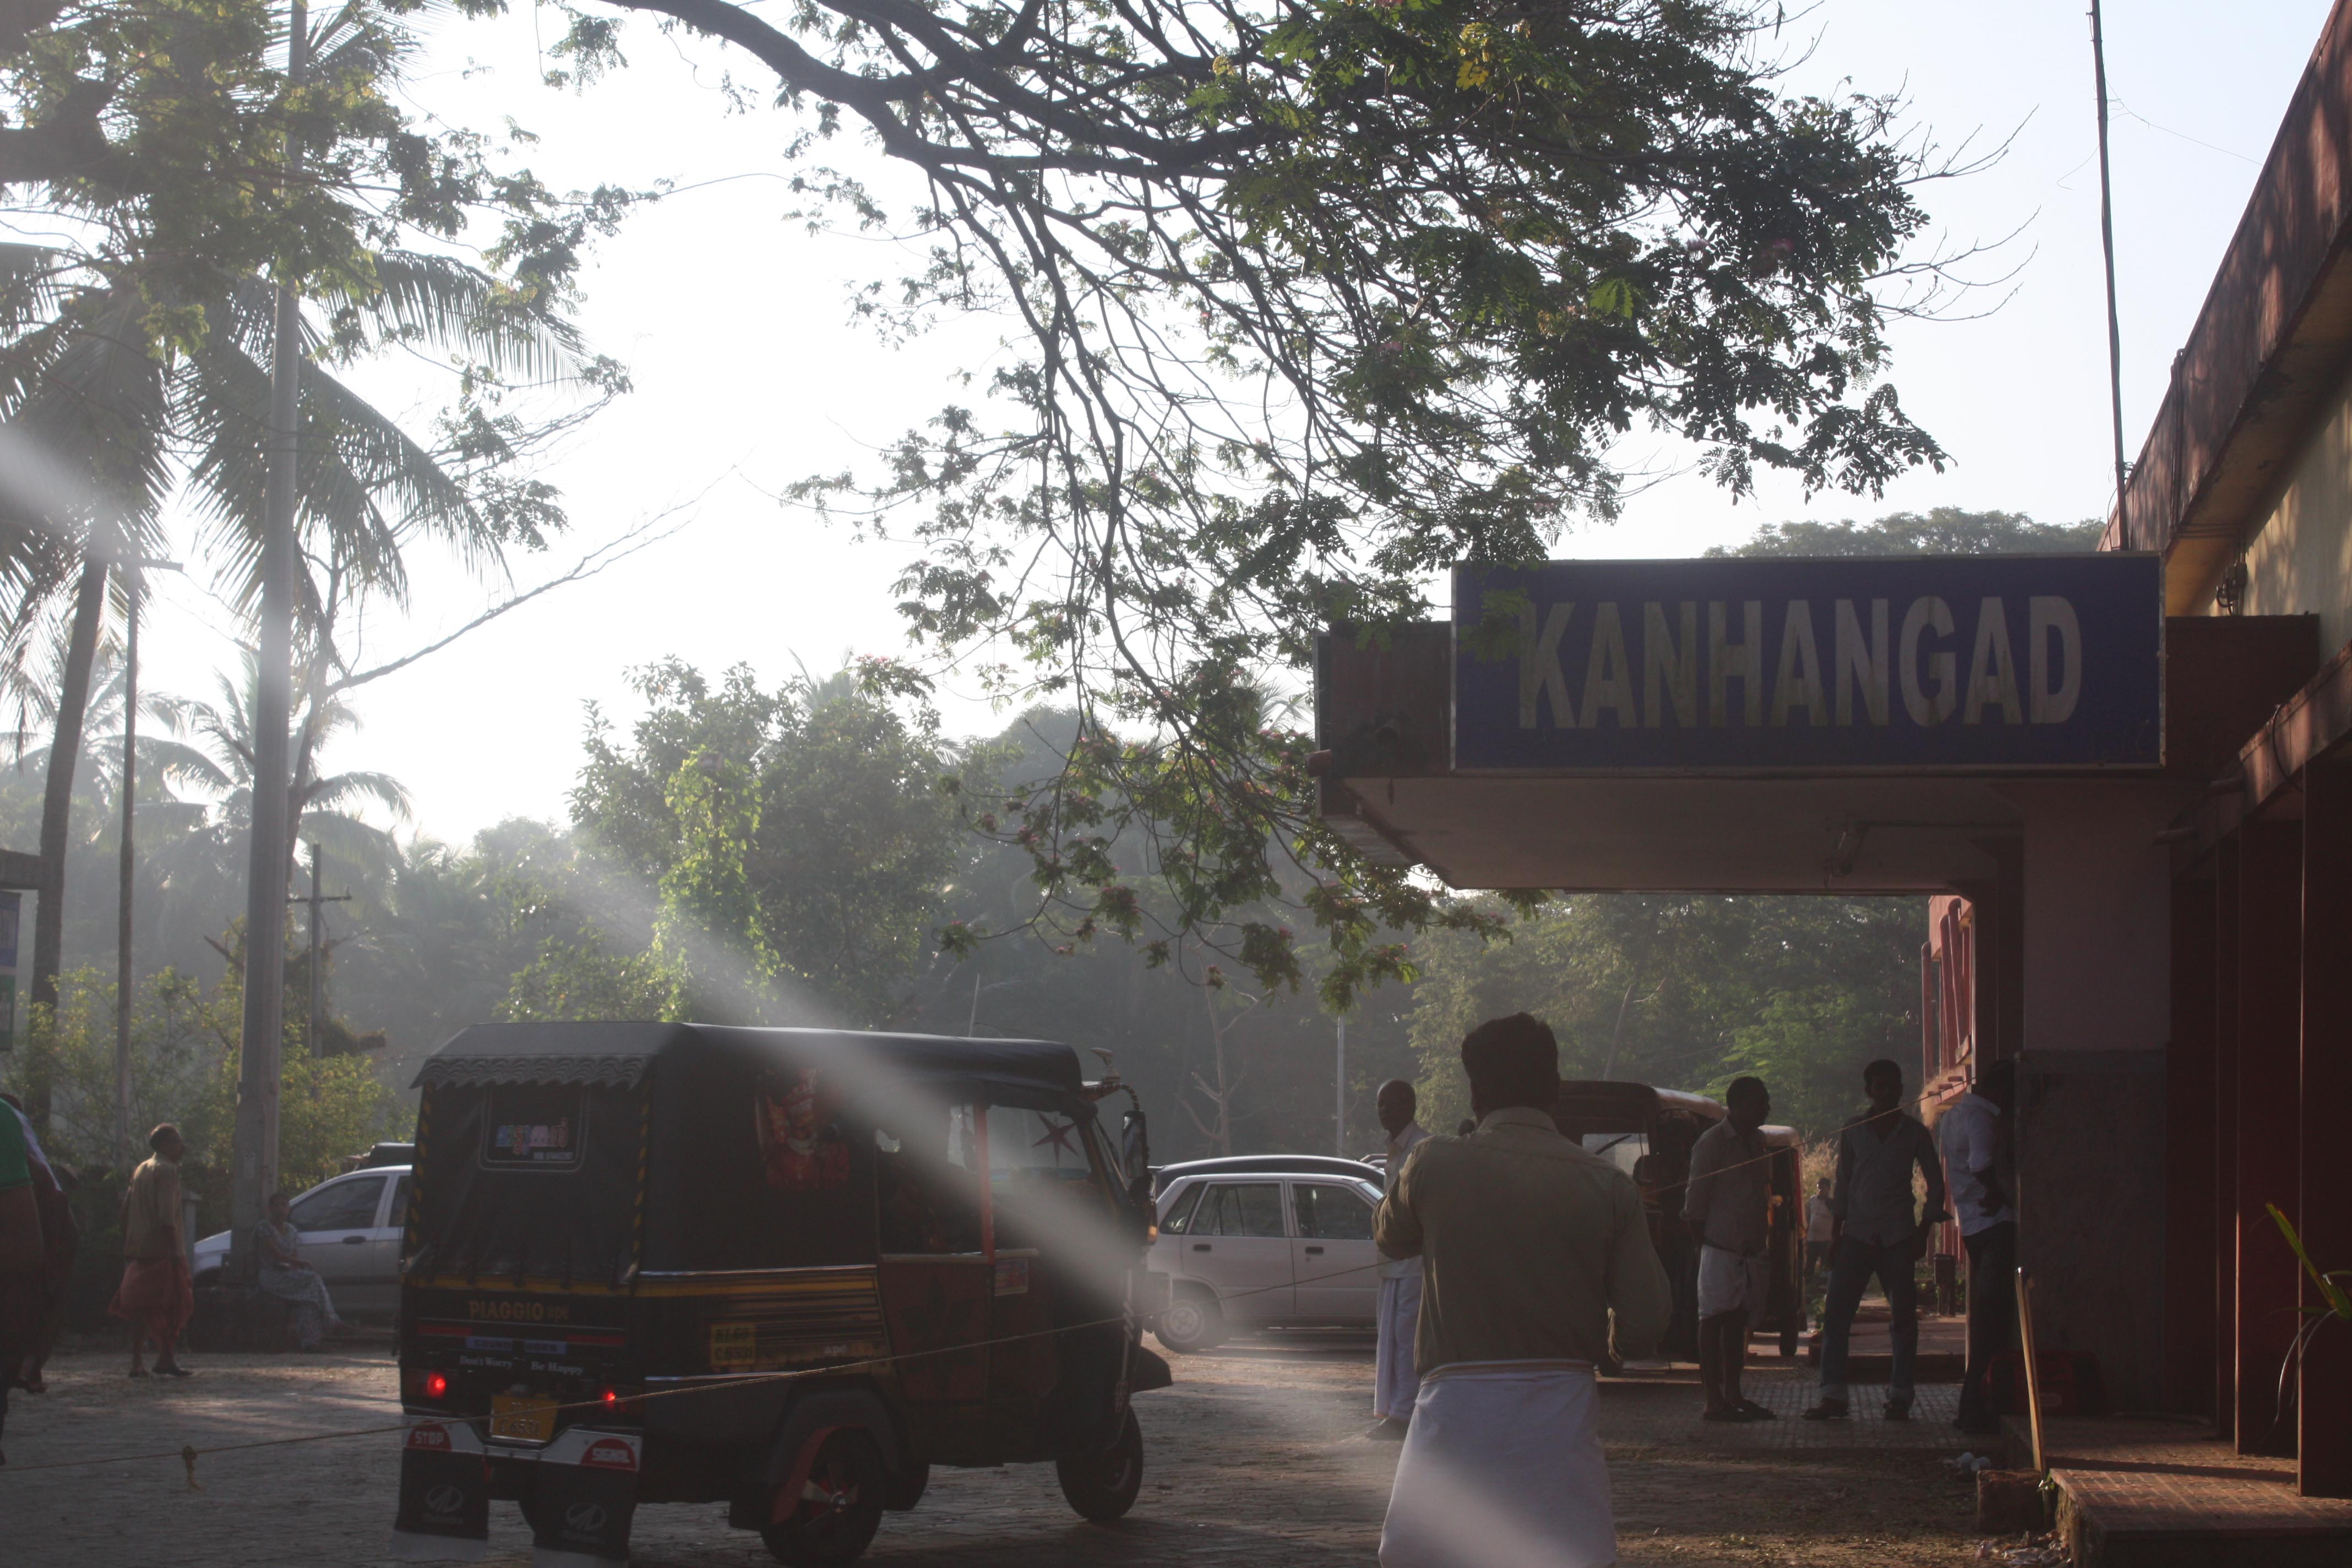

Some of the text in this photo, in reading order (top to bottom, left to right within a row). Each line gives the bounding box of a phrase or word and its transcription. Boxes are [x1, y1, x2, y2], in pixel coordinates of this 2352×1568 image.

[1519, 596, 2082, 729] KANHANGAD
[467, 1300, 570, 1322] PIAGGIO ape
[459, 1355, 584, 1375] Don't Worry Be Happy
[415, 1431, 444, 1445] STOP
[591, 1447, 630, 1464] SIGNAL
